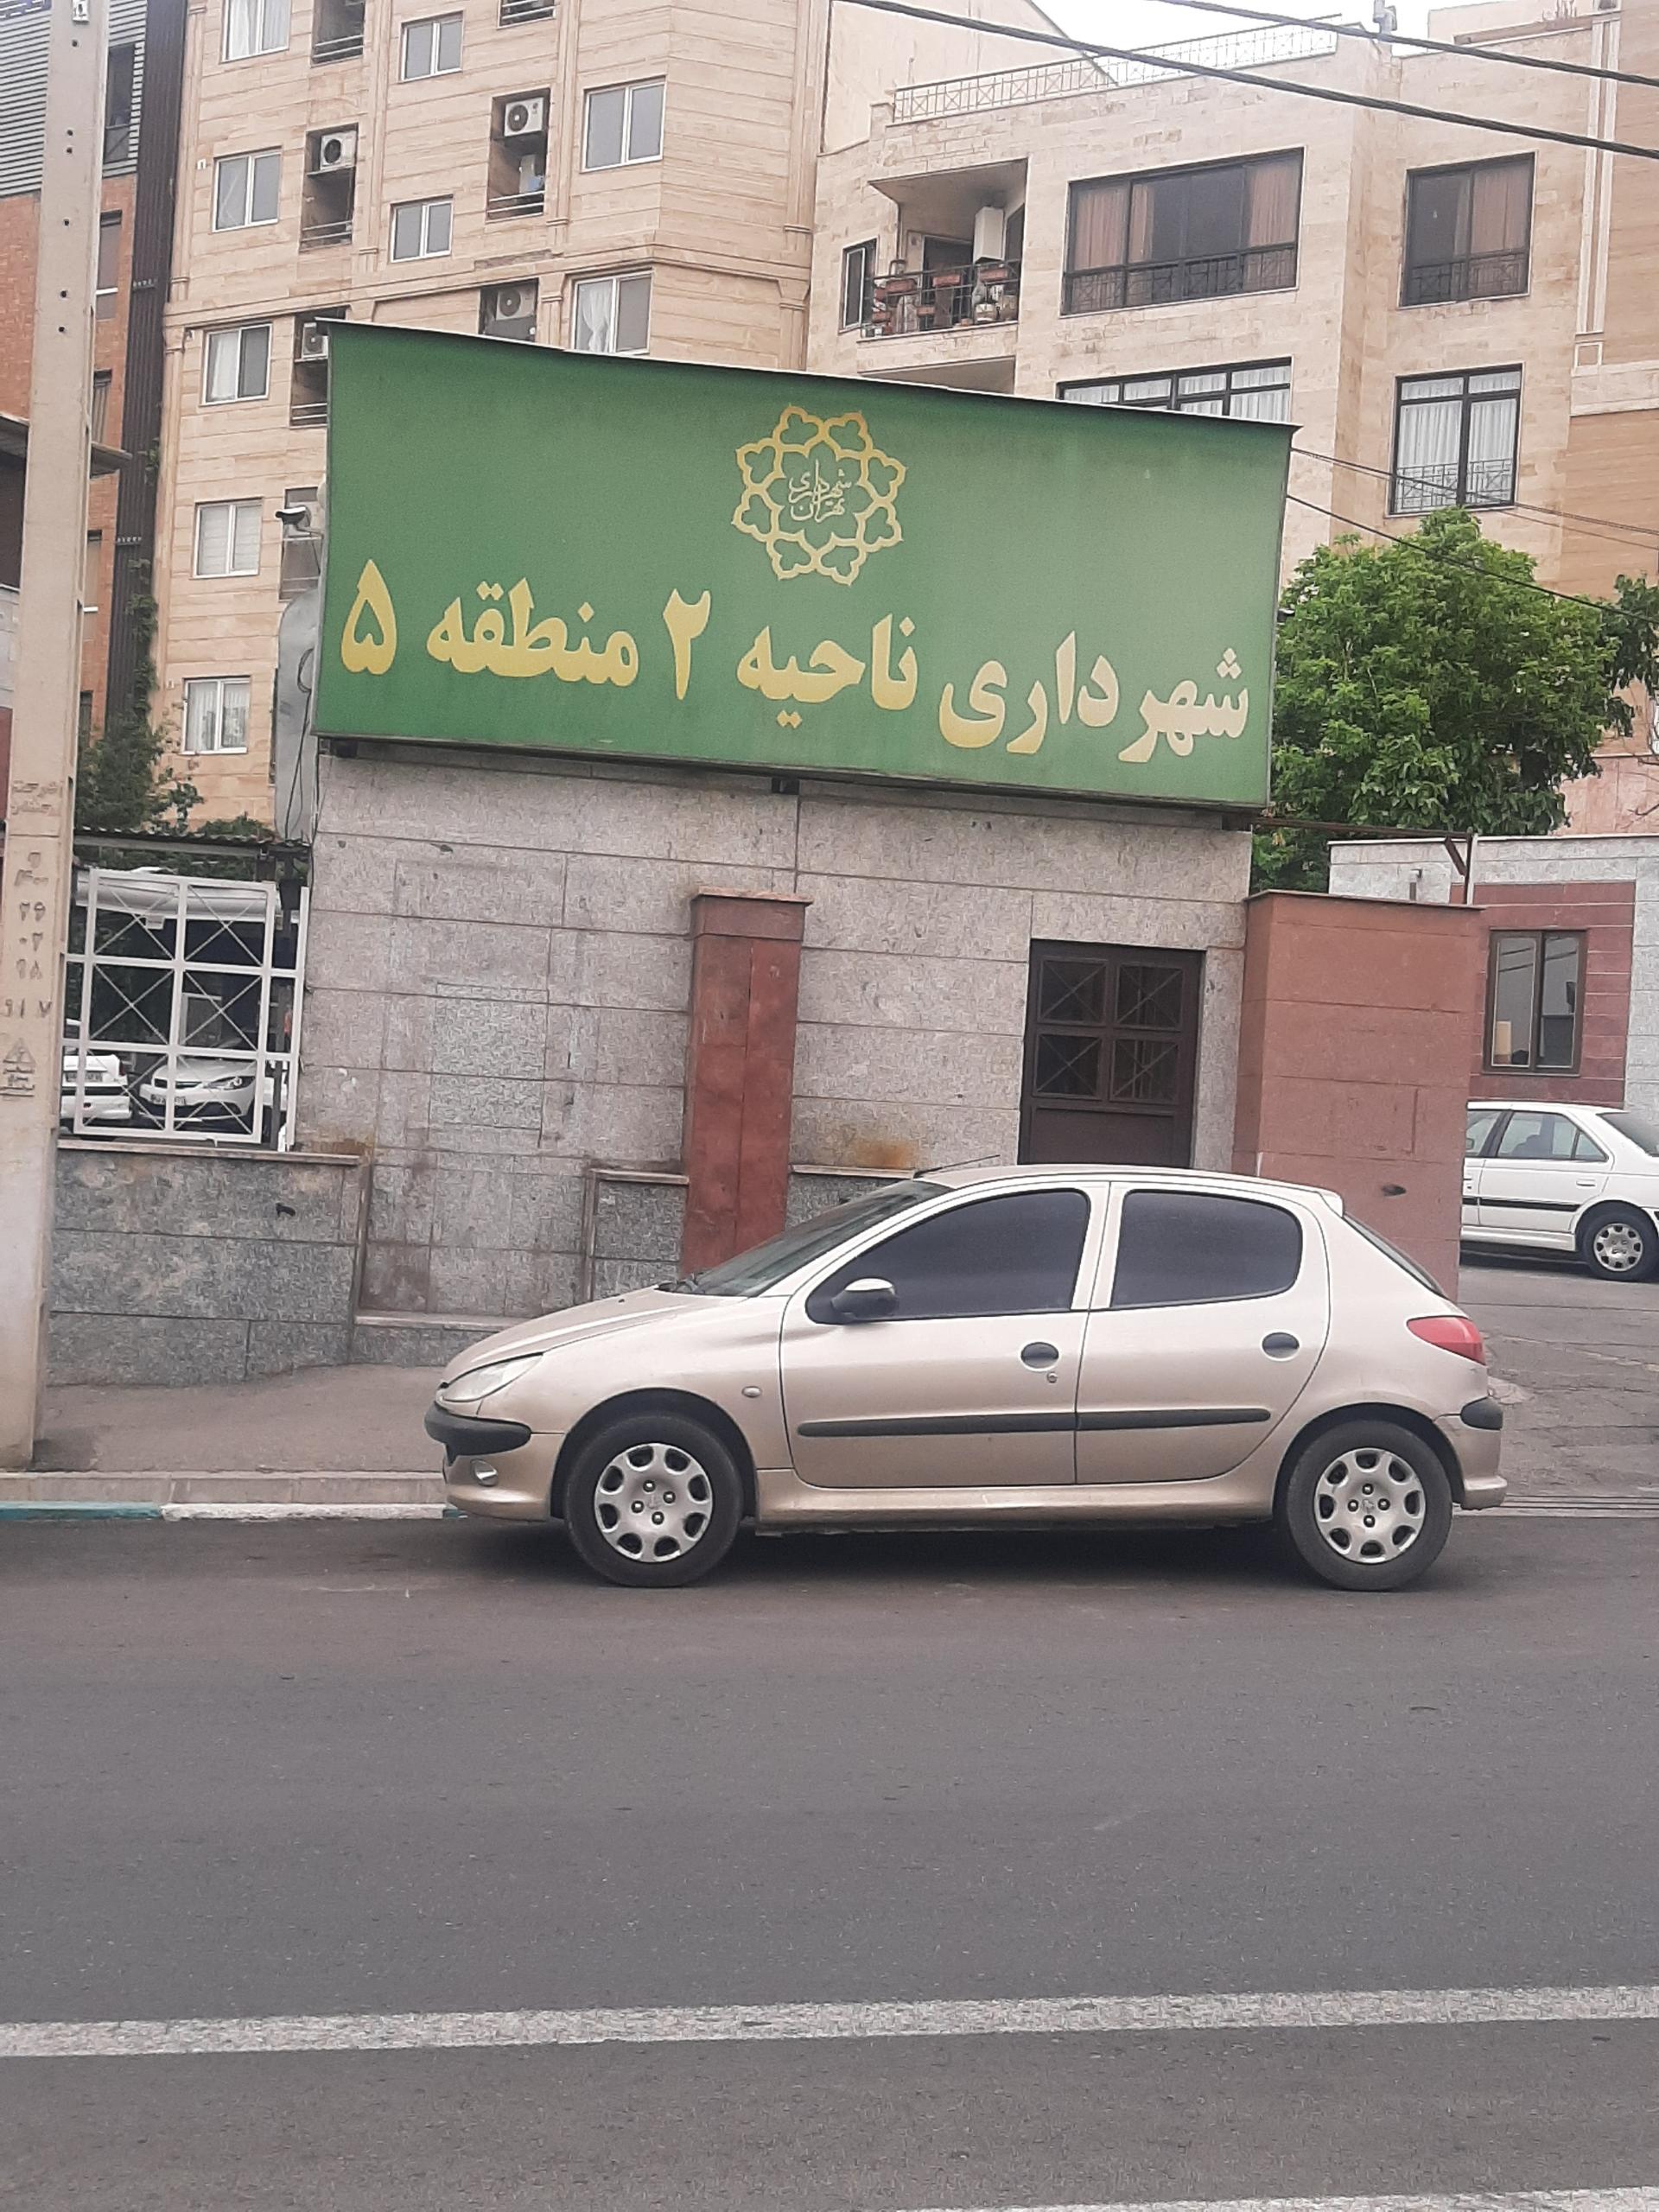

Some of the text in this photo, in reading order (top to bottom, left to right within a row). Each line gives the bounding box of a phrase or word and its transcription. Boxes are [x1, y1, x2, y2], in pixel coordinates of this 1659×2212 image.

[788, 459, 852, 505] شهرداری
[340, 562, 1249, 764] شهرداری ناحیه ۲ منطقه ۵
